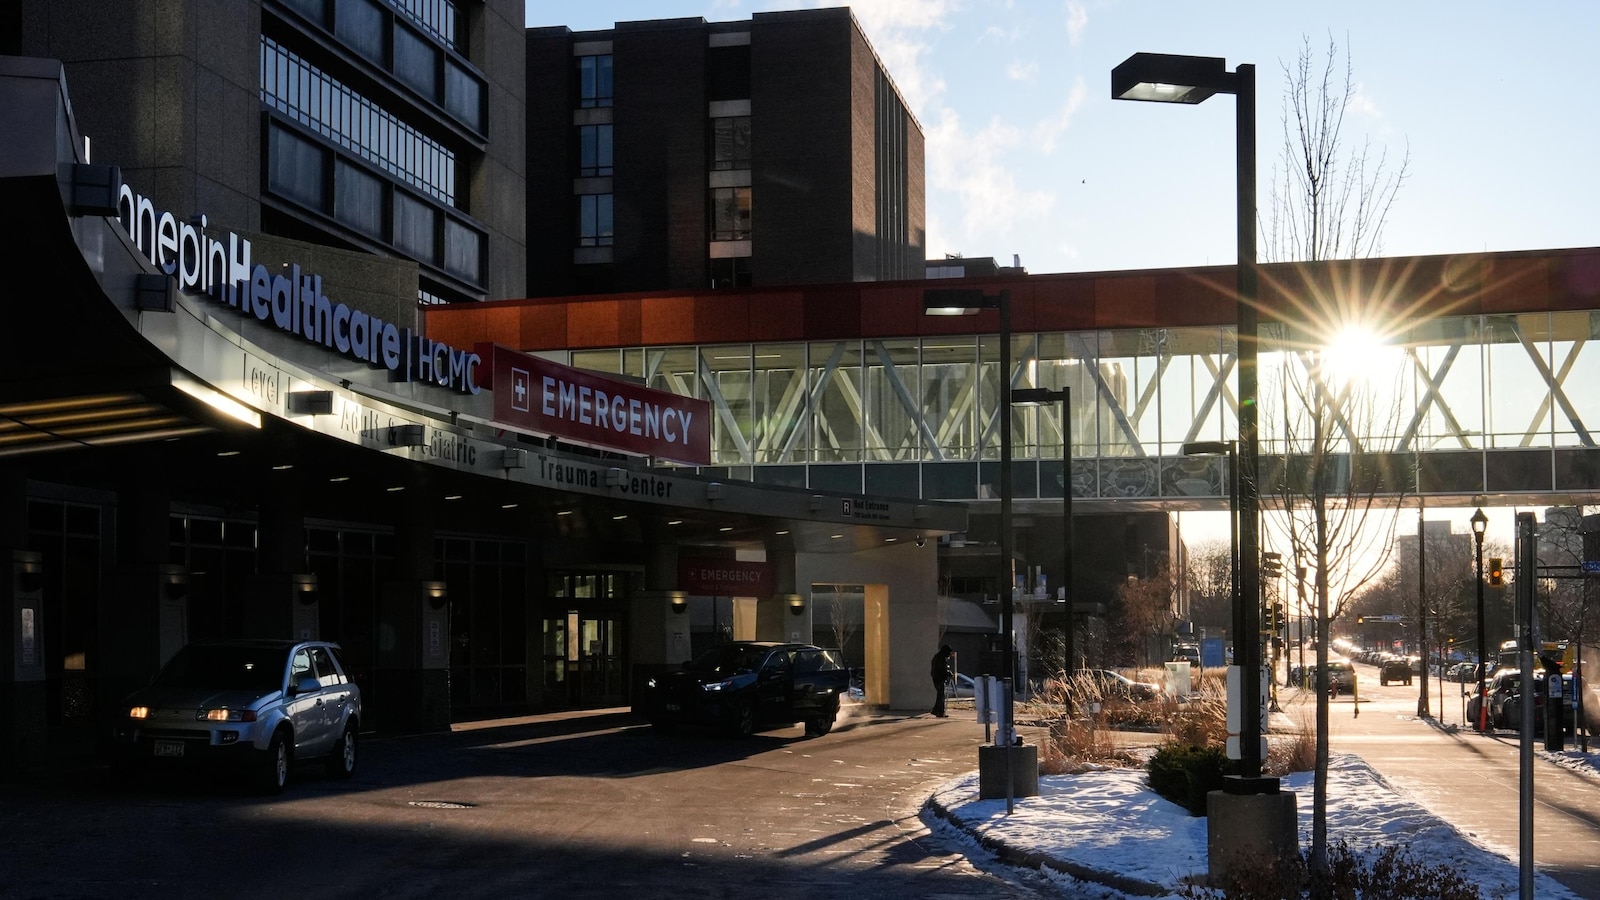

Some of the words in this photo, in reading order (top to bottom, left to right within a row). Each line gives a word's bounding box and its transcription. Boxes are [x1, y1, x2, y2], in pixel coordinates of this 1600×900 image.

[85, 136, 399, 370] nnepinHealthcare
[419, 335, 481, 396] HCMC
[243, 353, 280, 405] Level
[341, 400, 379, 442] Adult
[409, 430, 476, 466] diatric
[538, 454, 598, 488] Trauma
[542, 375, 692, 445] EMERGENCY
[700, 568, 762, 582] EMERGENCY
